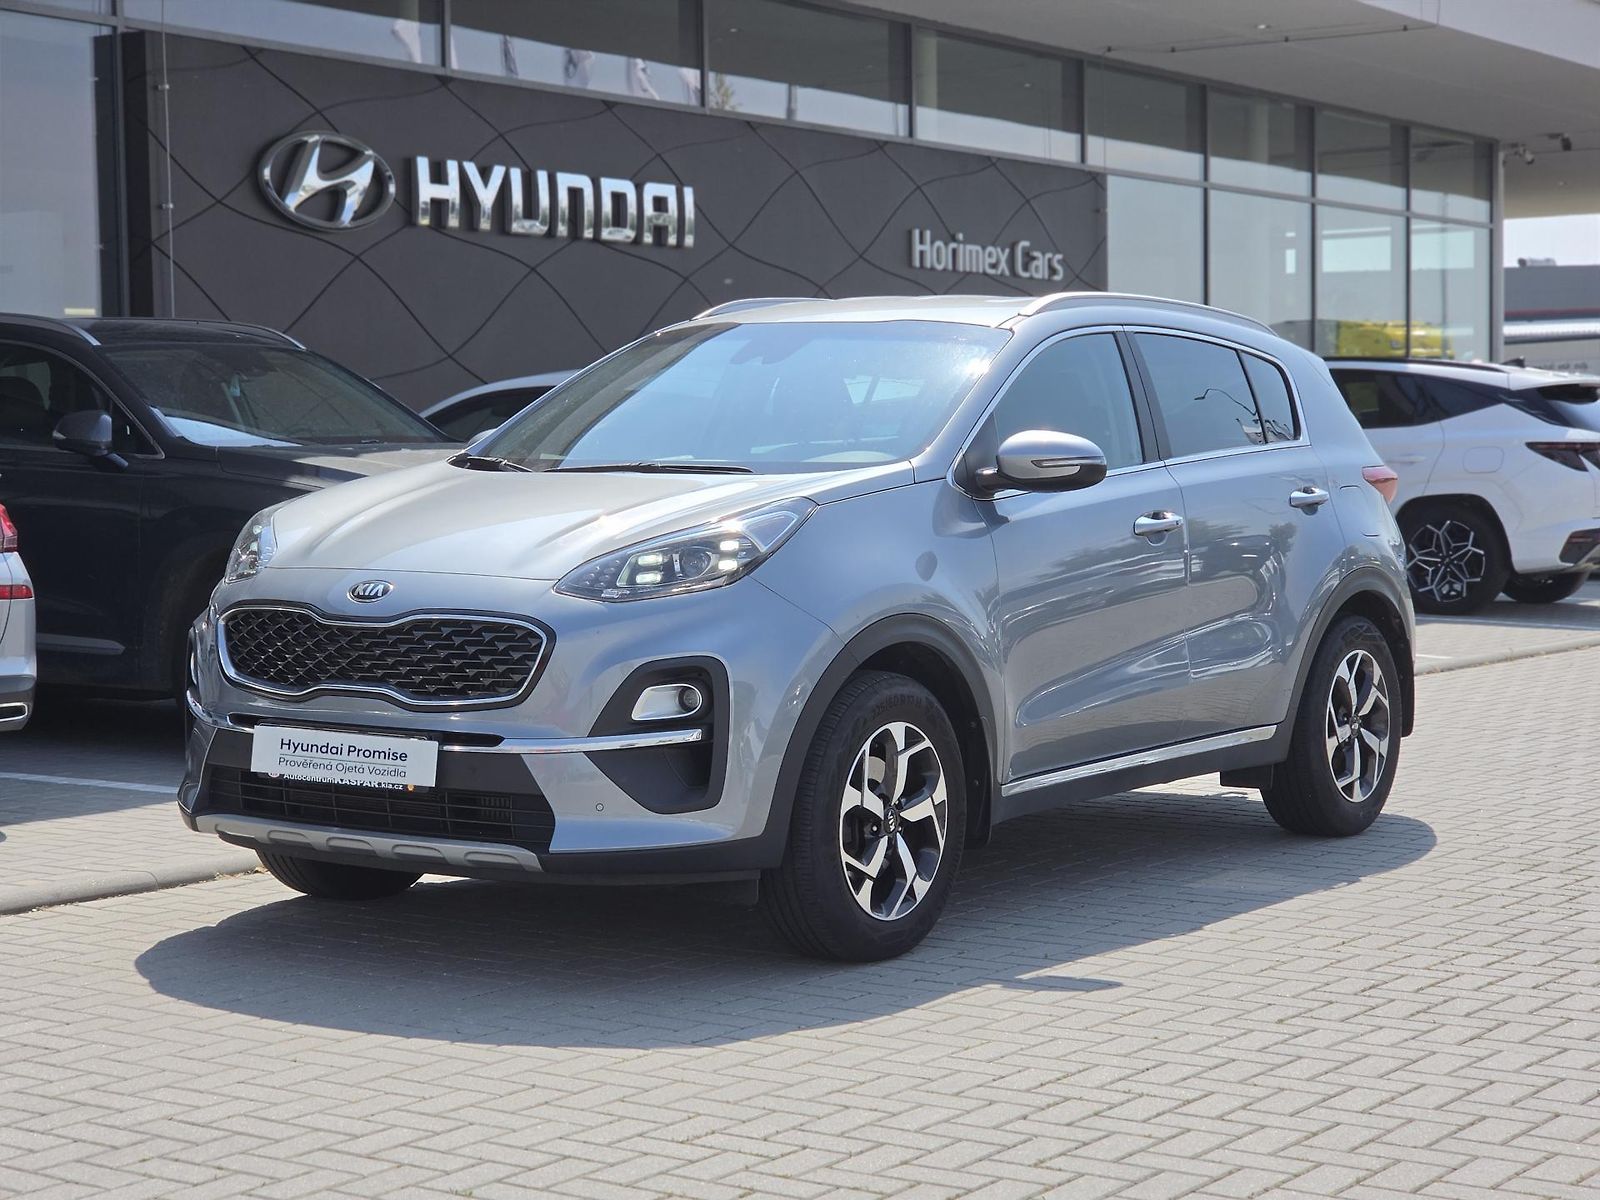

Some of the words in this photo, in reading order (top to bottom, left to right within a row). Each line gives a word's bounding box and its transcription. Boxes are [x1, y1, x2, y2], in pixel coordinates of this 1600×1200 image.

[415, 156, 695, 249] HYUNDAI
[911, 228, 1010, 277] Horimex
[1014, 240, 1064, 281] Cars
[278, 756, 333, 771] Prověřená
[335, 762, 365, 775] Ojetá
[367, 766, 407, 778] Vozidla
[280, 738, 343, 756] Hyundai
[347, 744, 408, 762] Promise
